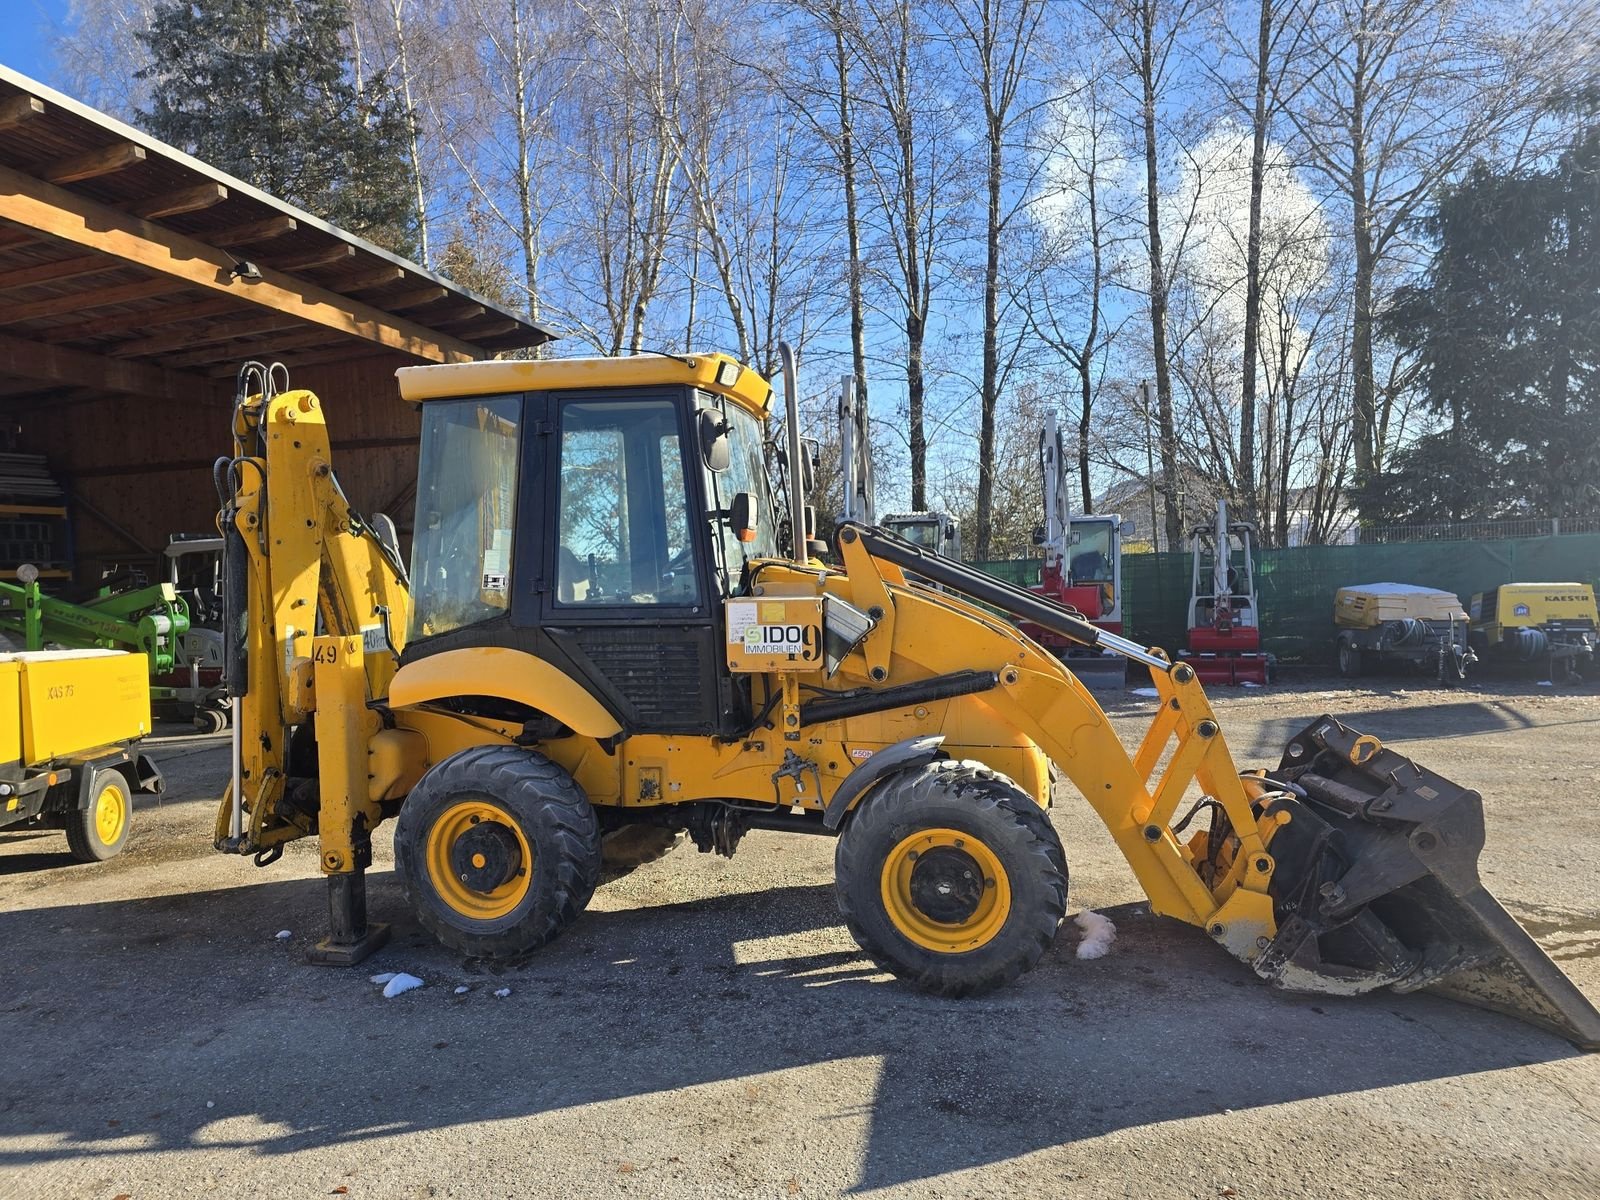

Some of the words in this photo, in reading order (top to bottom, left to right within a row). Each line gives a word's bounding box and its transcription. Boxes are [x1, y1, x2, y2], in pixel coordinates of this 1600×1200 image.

[745, 626, 801, 644] SIDO
[315, 645, 337, 664] 49
[745, 644, 801, 654] IMMOBILIEN
[47, 685, 63, 700] XAS
